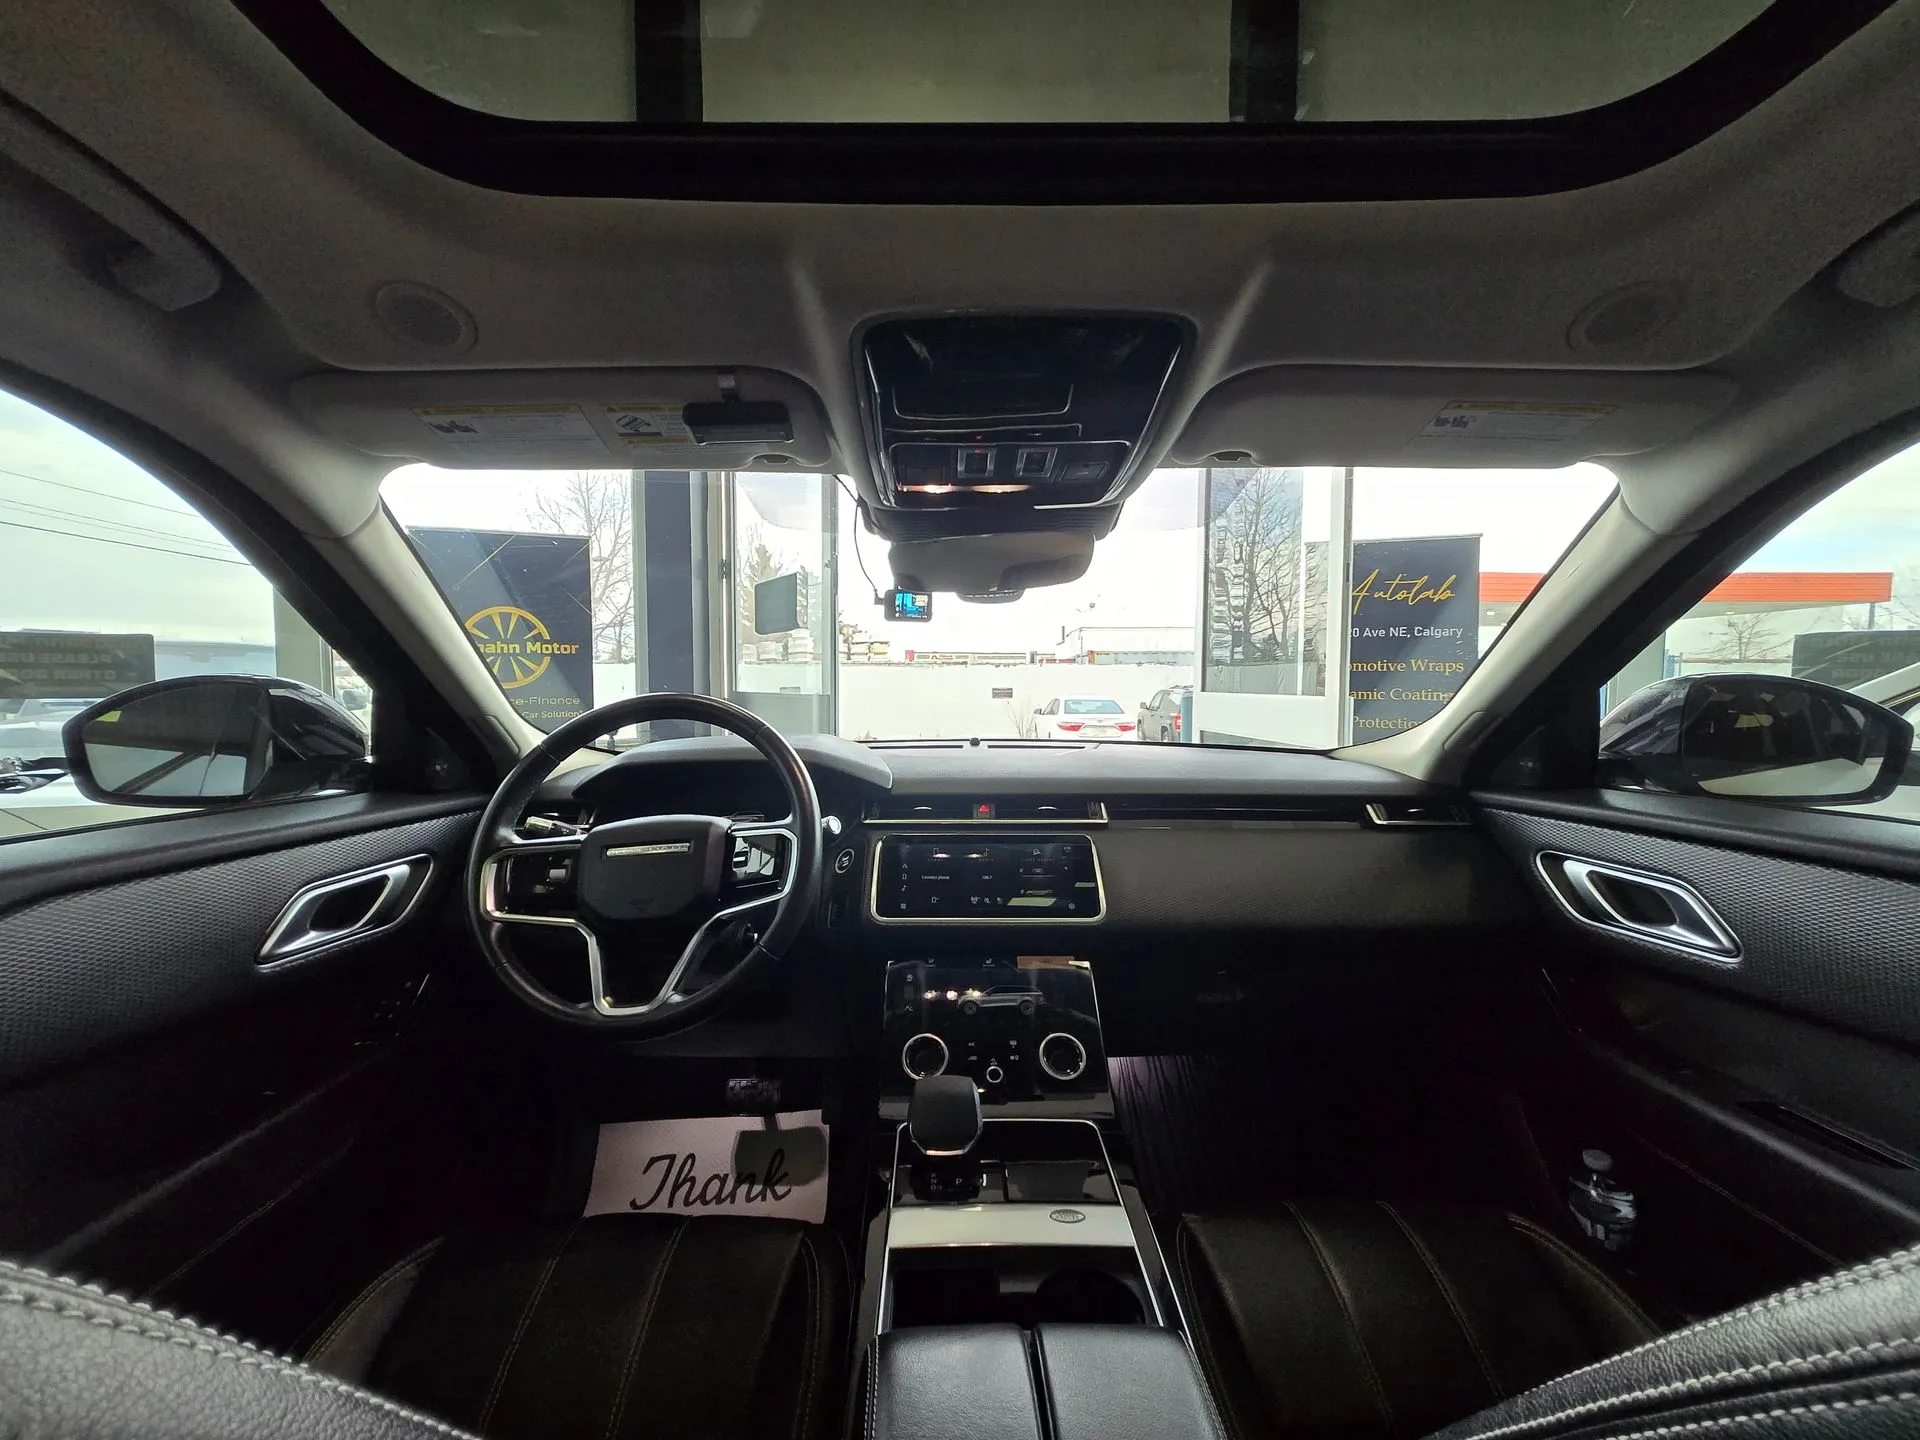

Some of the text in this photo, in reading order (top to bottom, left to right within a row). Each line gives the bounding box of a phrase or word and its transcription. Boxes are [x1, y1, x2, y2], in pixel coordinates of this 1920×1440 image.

[1351, 568, 1456, 615] Autolab
[1363, 626, 1386, 638] Ave
[1389, 626, 1411, 638] NE,
[1414, 626, 1463, 638] Calgary
[526, 641, 580, 654] Motor
[1410, 659, 1465, 676] Wraps
[522, 710, 583, 719] Car Solution
[629, 1148, 792, 1211] Thank
